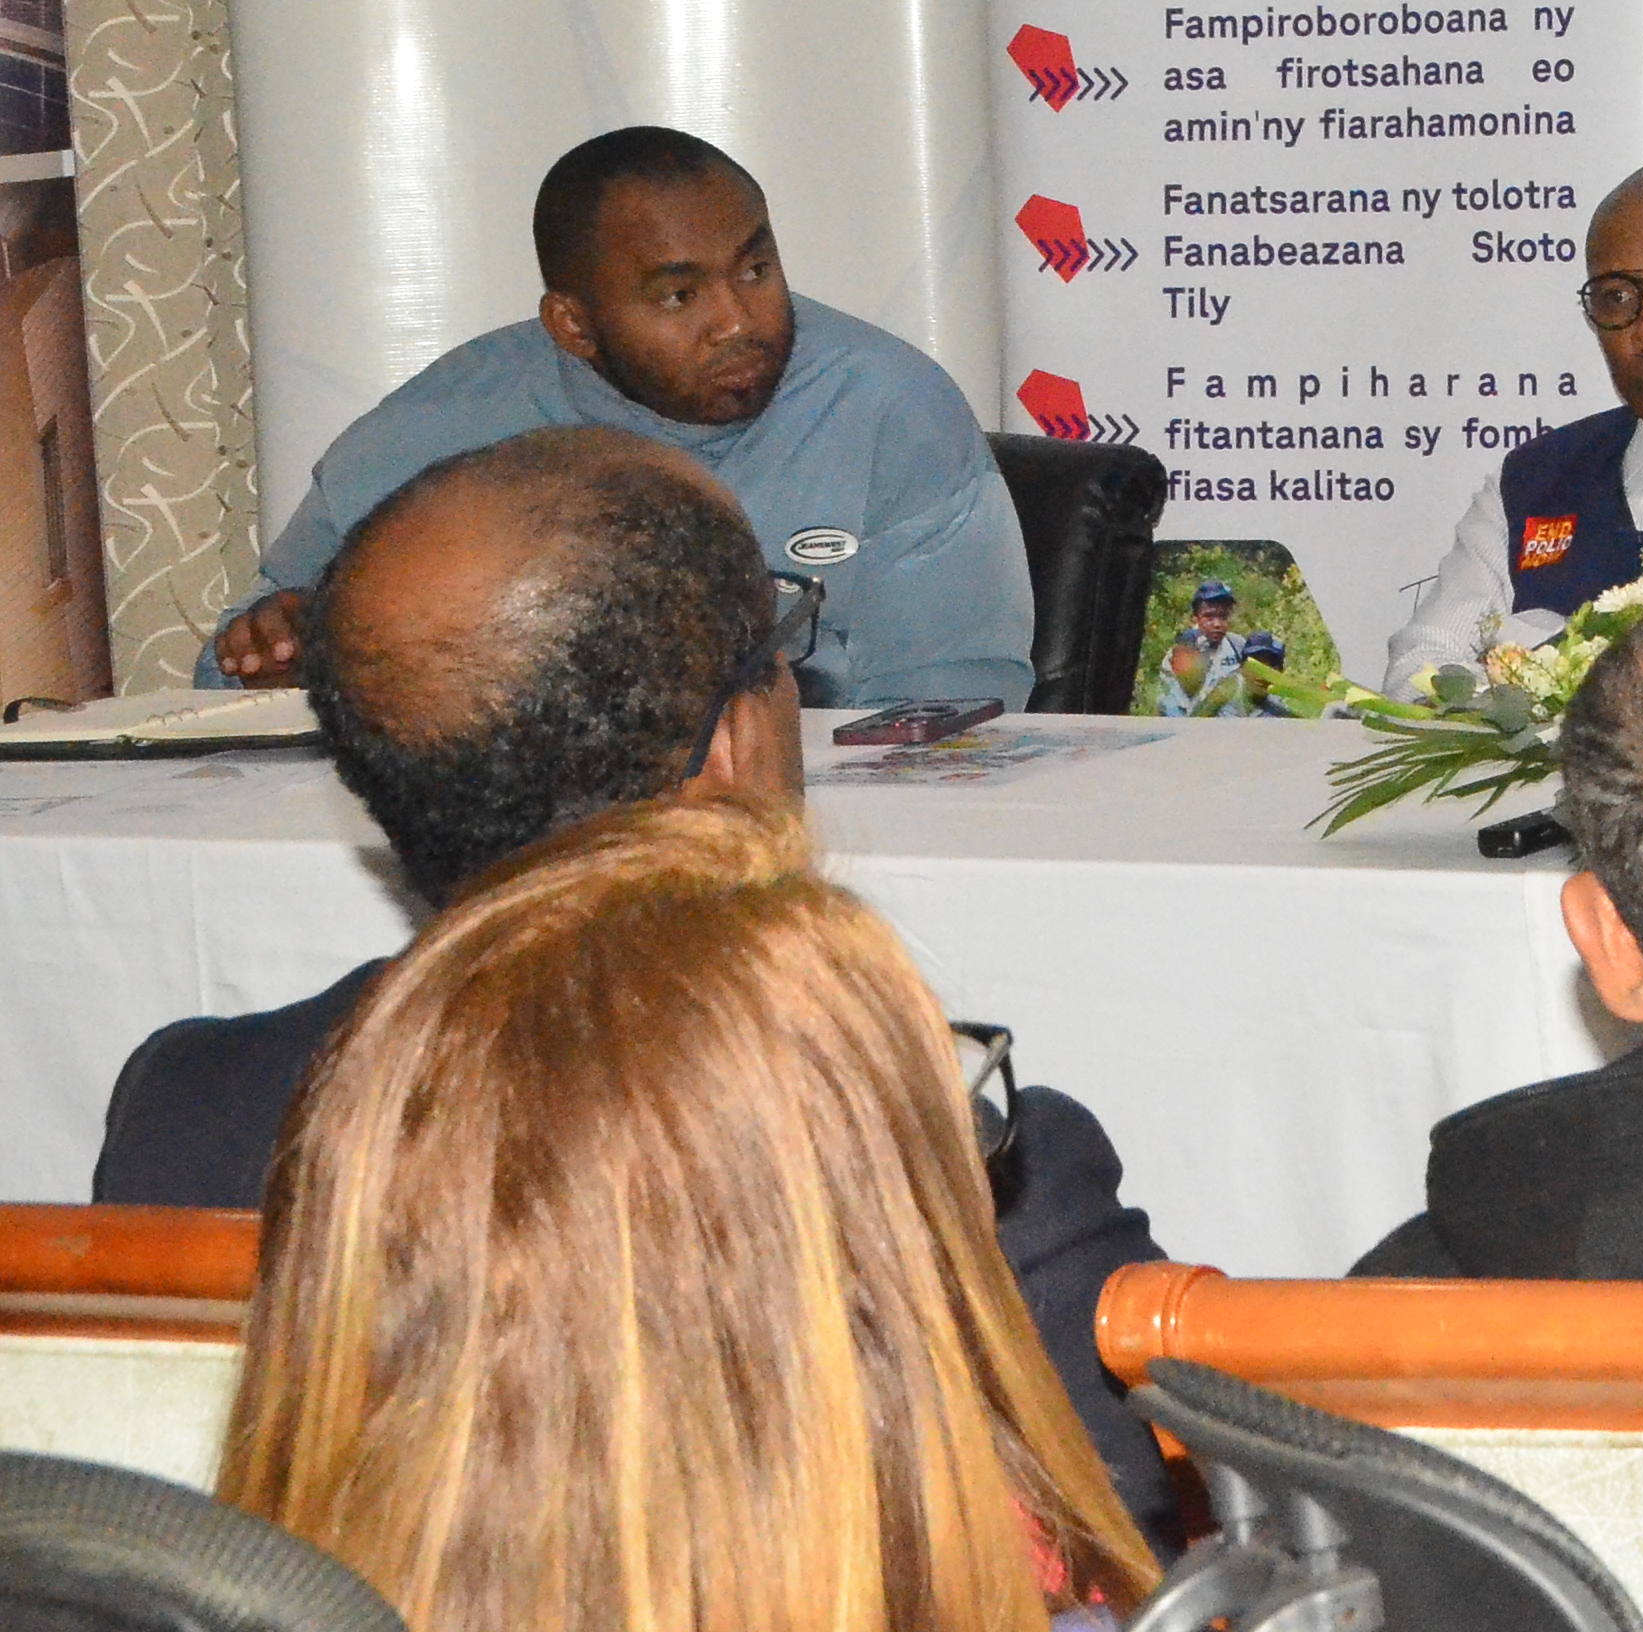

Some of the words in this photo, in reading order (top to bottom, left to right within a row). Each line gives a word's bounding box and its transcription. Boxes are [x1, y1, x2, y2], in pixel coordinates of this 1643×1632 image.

[1163, 4, 1509, 46] Fampiroboroboana
[1533, 4, 1576, 36] ny
[1163, 65, 1227, 92] asa
[1277, 55, 1486, 90] firotsahana
[1531, 60, 1576, 84] eo
[1163, 110, 1306, 148] amin'ny
[1318, 104, 1577, 141] fiarahamonina
[1163, 183, 1391, 217] Fanatsarana
[1402, 186, 1442, 220] ny
[1452, 179, 1578, 211] tolotra
[1163, 234, 1406, 267] Fanabeazana
[1471, 230, 1578, 265] Skoto
[1163, 287, 1232, 325] Tily
[1164, 418, 1385, 450] fitantanana
[1404, 425, 1442, 456] sy
[1165, 469, 1258, 501] fiasa
[1269, 469, 1396, 501] kalitao
[1524, 535, 1573, 557] POLIO
[1535, 521, 1573, 541] END
